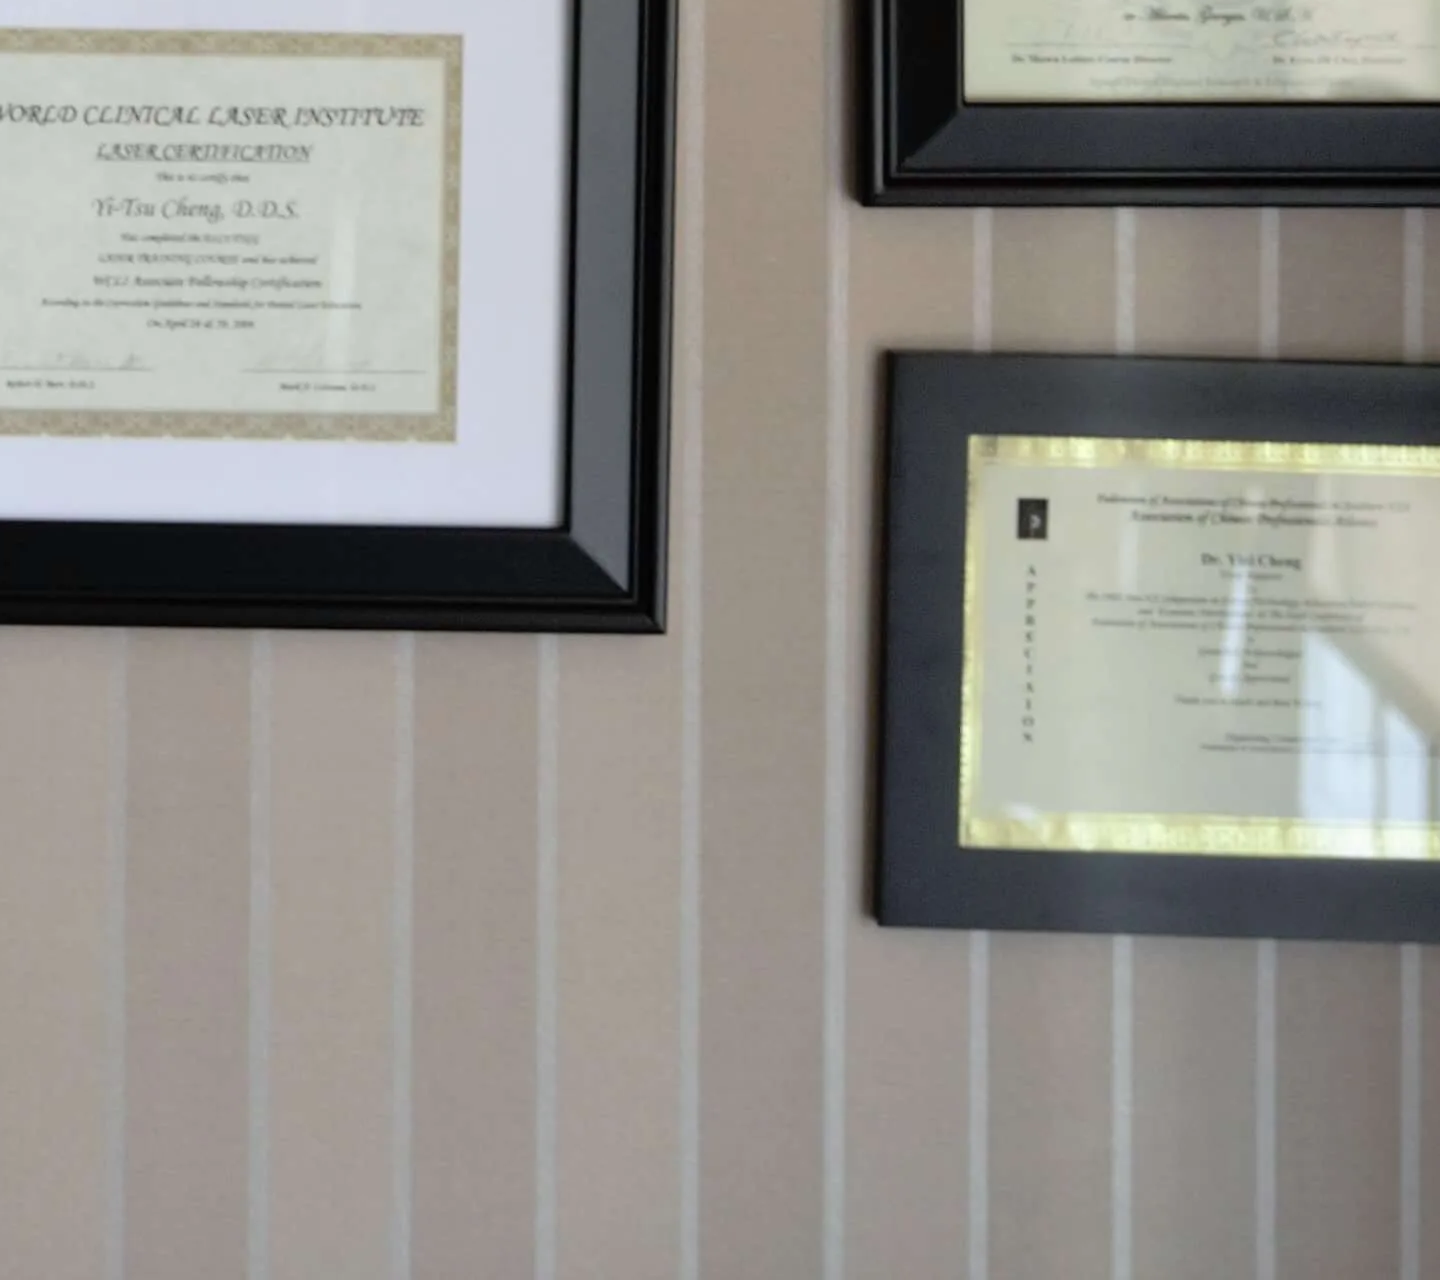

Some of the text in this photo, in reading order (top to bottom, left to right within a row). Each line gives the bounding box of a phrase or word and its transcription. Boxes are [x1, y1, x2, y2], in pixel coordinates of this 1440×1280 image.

[82, 104, 199, 127] CLINICAL
[206, 105, 291, 129] LASER
[292, 106, 426, 128] INSTITUTE
[91, 197, 155, 218] Yi-Tsu
